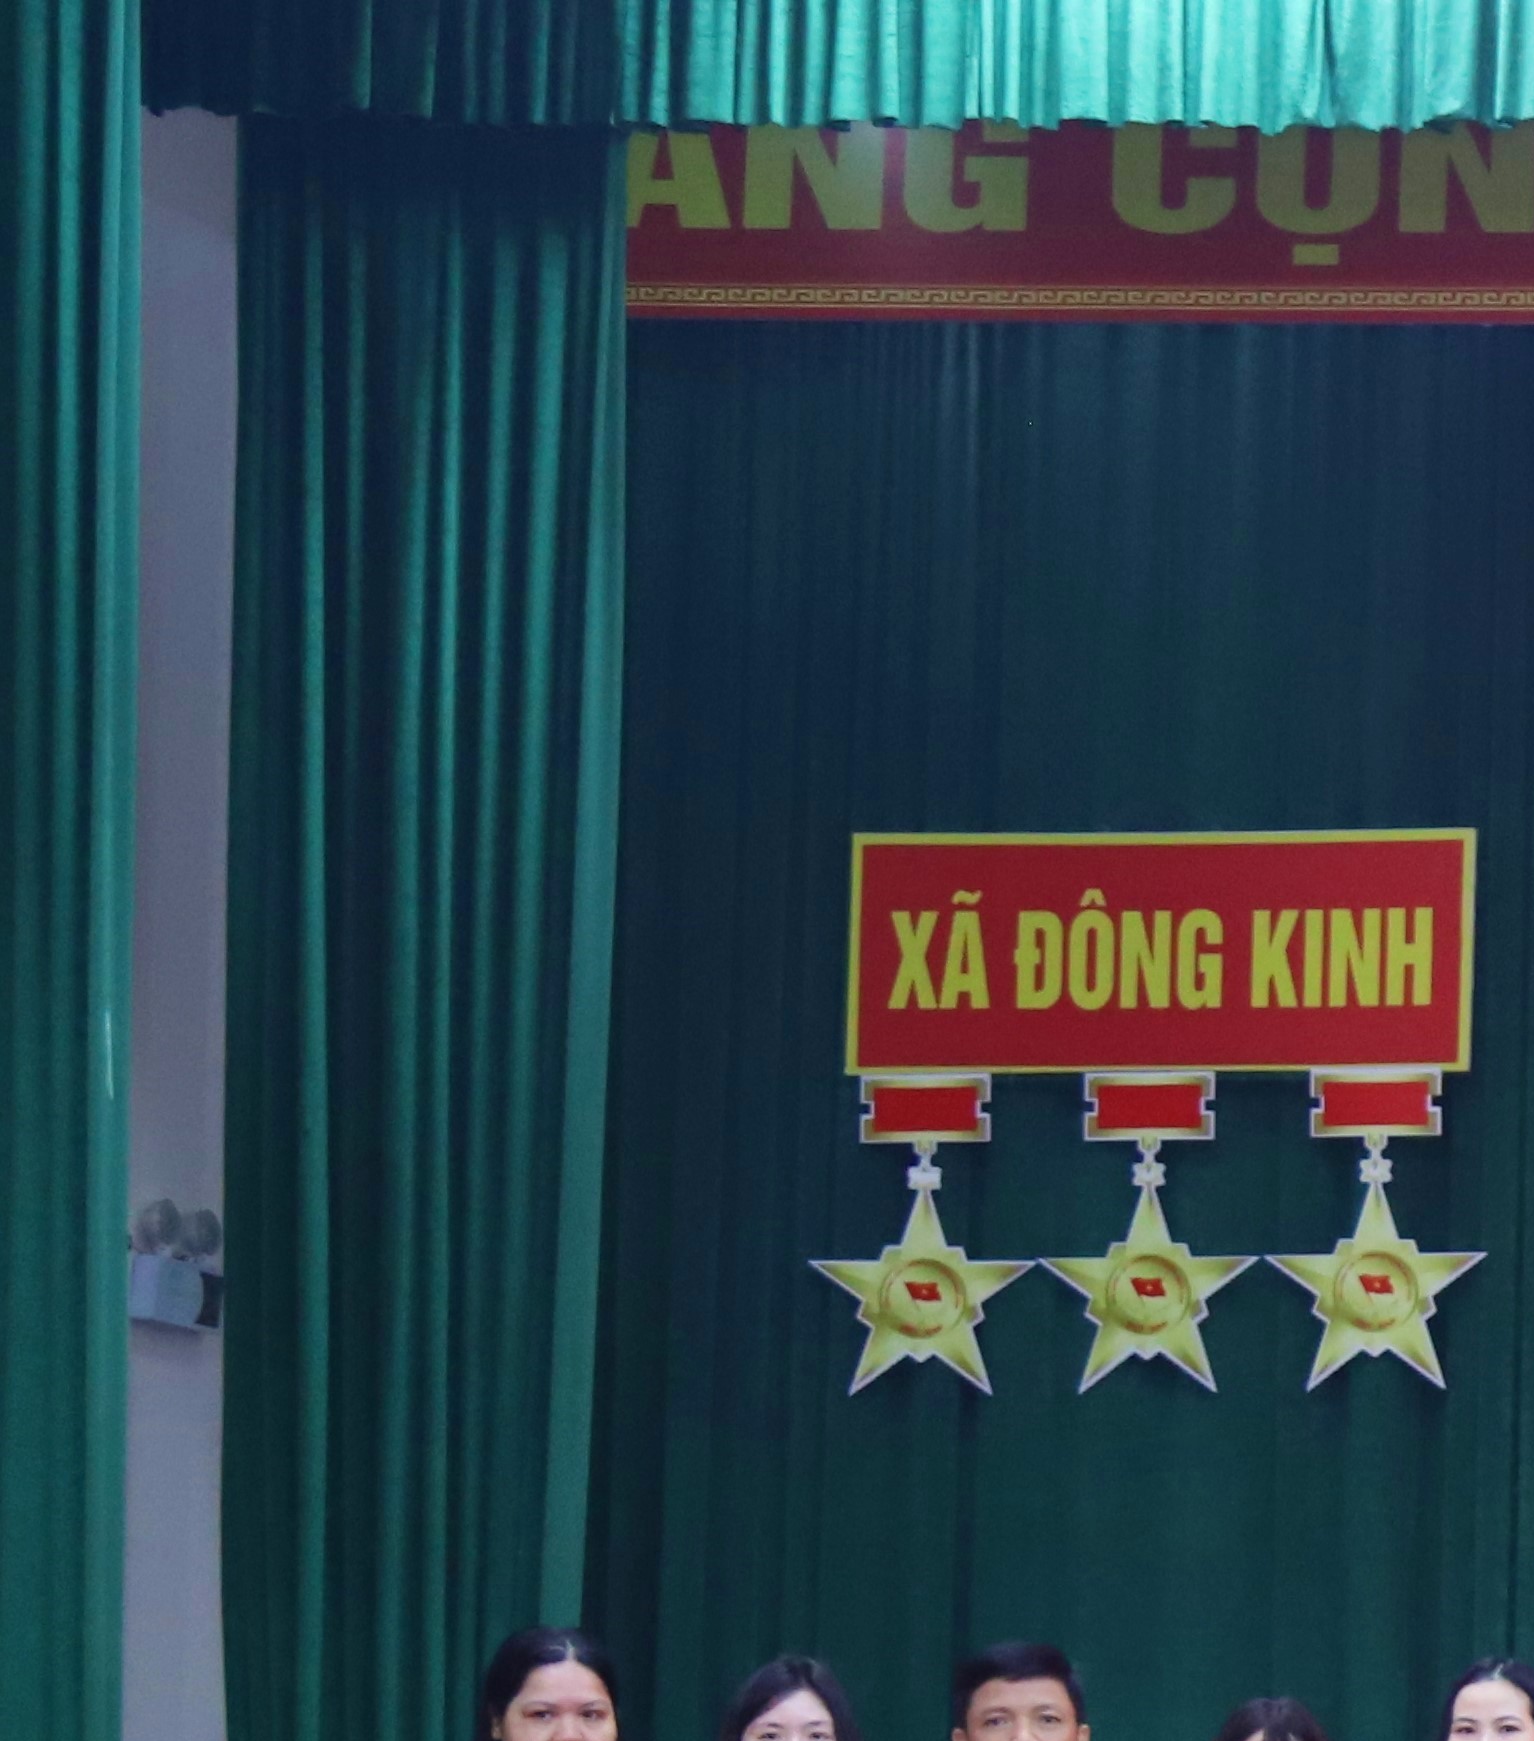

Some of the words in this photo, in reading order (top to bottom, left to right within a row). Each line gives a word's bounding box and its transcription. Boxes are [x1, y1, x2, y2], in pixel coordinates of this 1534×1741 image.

[888, 891, 989, 1010] XÃ
[1014, 889, 1223, 1010] ĐÔNG
[1251, 907, 1433, 1007] KINH
